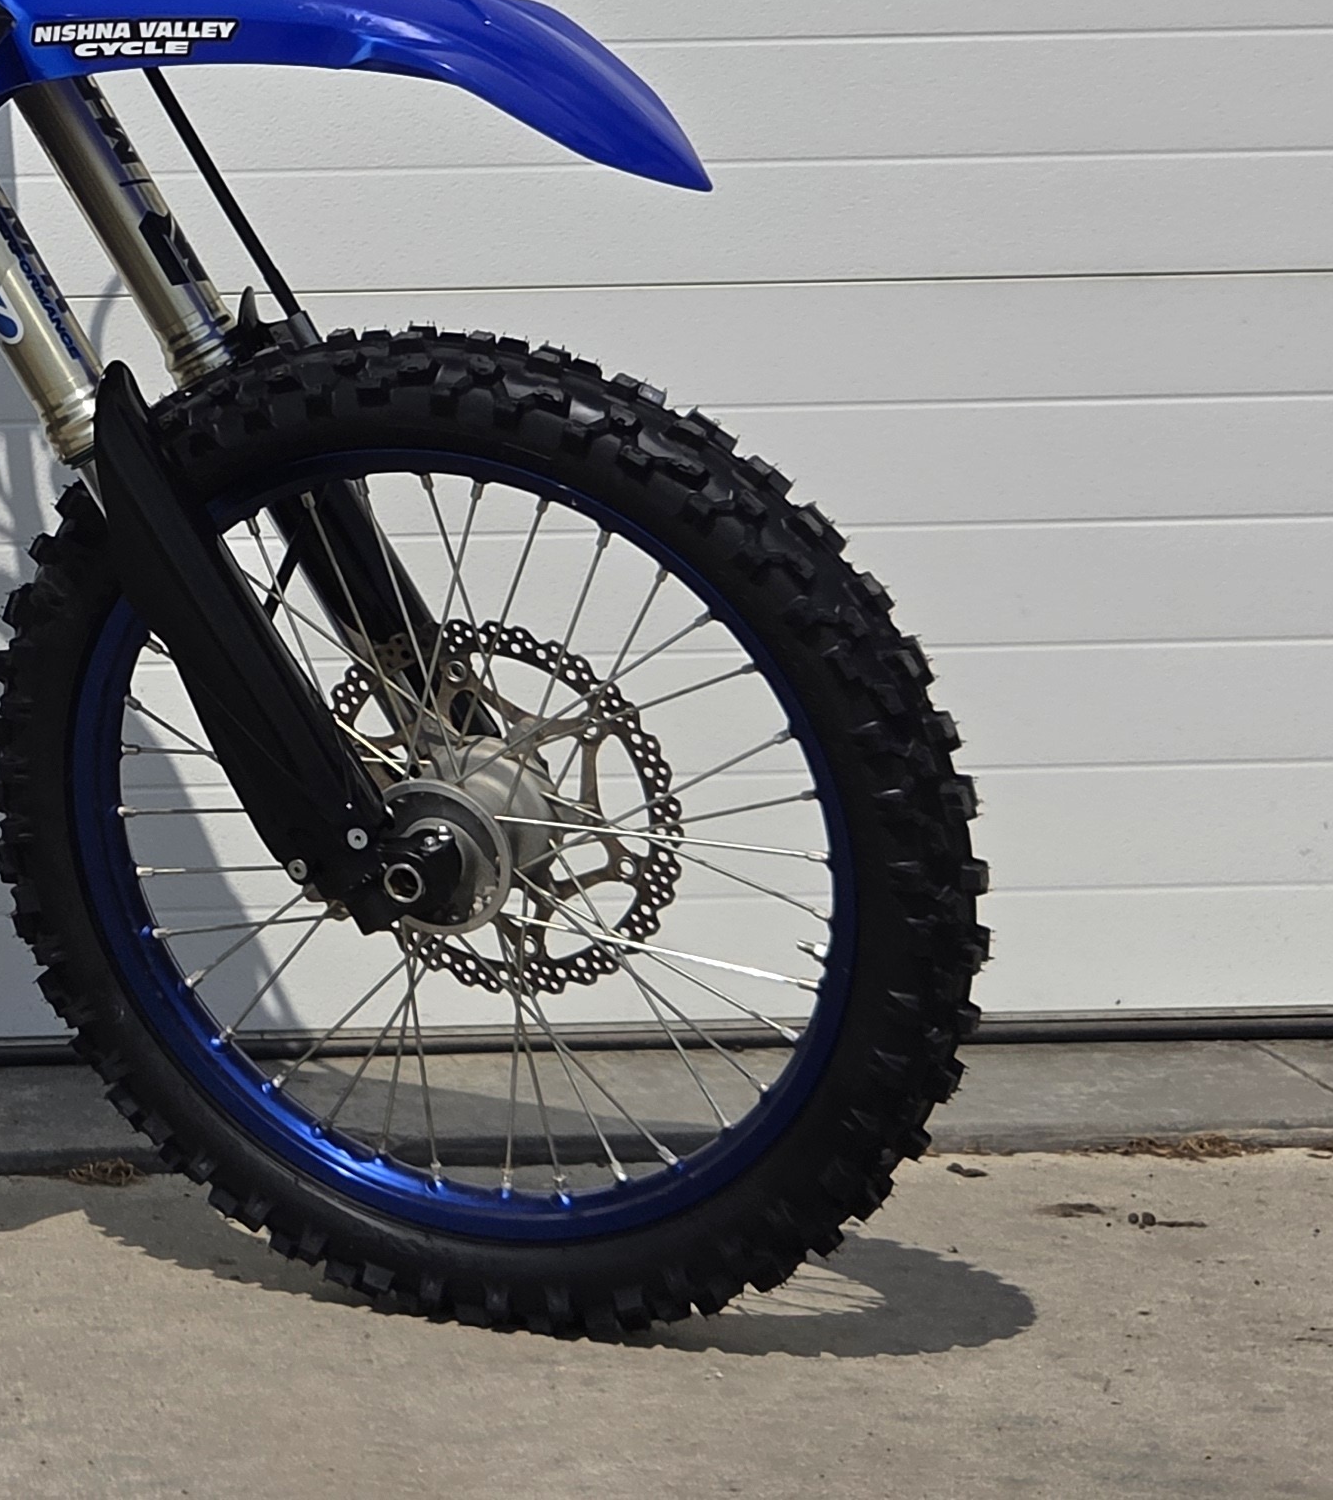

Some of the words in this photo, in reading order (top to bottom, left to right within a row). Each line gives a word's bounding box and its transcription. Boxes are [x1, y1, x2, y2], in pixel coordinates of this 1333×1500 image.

[34, 22, 131, 43] NISHNA
[139, 21, 236, 38] VALLEY
[74, 41, 189, 57] CYCLE
